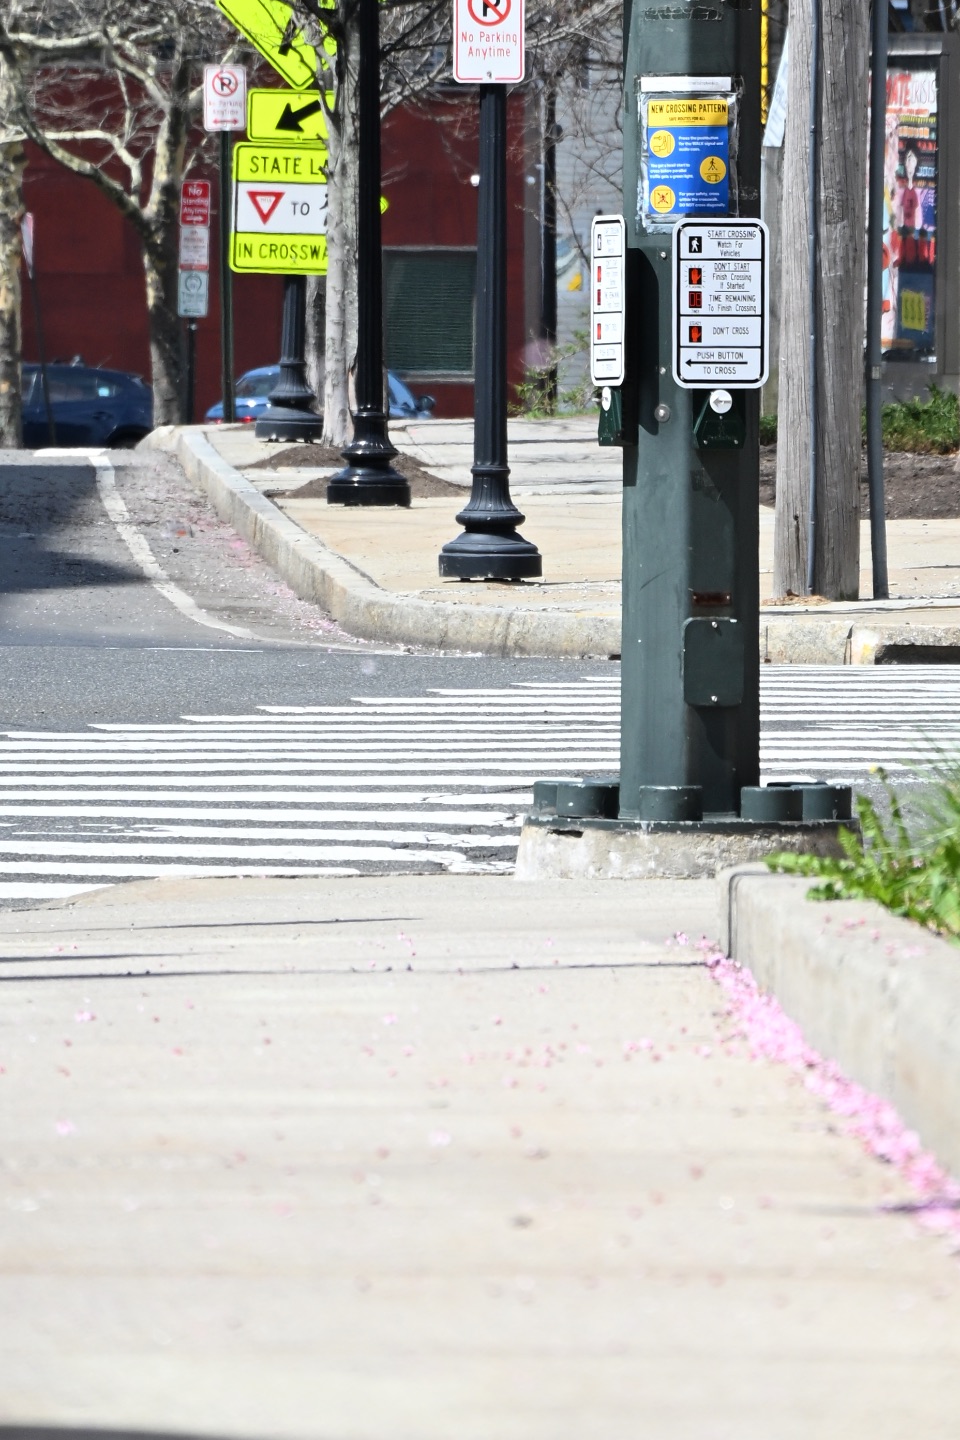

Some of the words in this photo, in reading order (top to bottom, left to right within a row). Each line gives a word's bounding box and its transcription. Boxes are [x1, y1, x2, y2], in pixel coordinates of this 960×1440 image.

[461, 31, 474, 43] No
[479, 31, 517, 46] Parking
[467, 46, 511, 60] Anytime
[651, 104, 664, 114] NEW
[665, 103, 697, 114] CROSSING
[698, 103, 727, 113] PATTERN
[249, 155, 302, 175] STATE
[188, 186, 203, 197] No
[290, 201, 310, 216] TO
[707, 230, 726, 238] START
[728, 230, 757, 238] CROSSING
[238, 242, 253, 259] IN
[714, 262, 731, 271] DON'T
[733, 262, 750, 271] START
[712, 272, 728, 281] Finish
[730, 273, 752, 283] Crossing
[720, 282, 724, 290] If
[726, 282, 745, 290] Started
[709, 294, 722, 303] TIME
[725, 294, 756, 303] REMAINING
[708, 304, 714, 312] To
[717, 304, 732, 312] Finish
[735, 304, 757, 314] Crossing
[712, 326, 730, 335] DON'T
[731, 326, 750, 335] CROSS
[696, 351, 715, 360] PUSH
[717, 351, 744, 360] BUTTON
[703, 366, 712, 375] TO
[714, 366, 737, 375] CROSS
